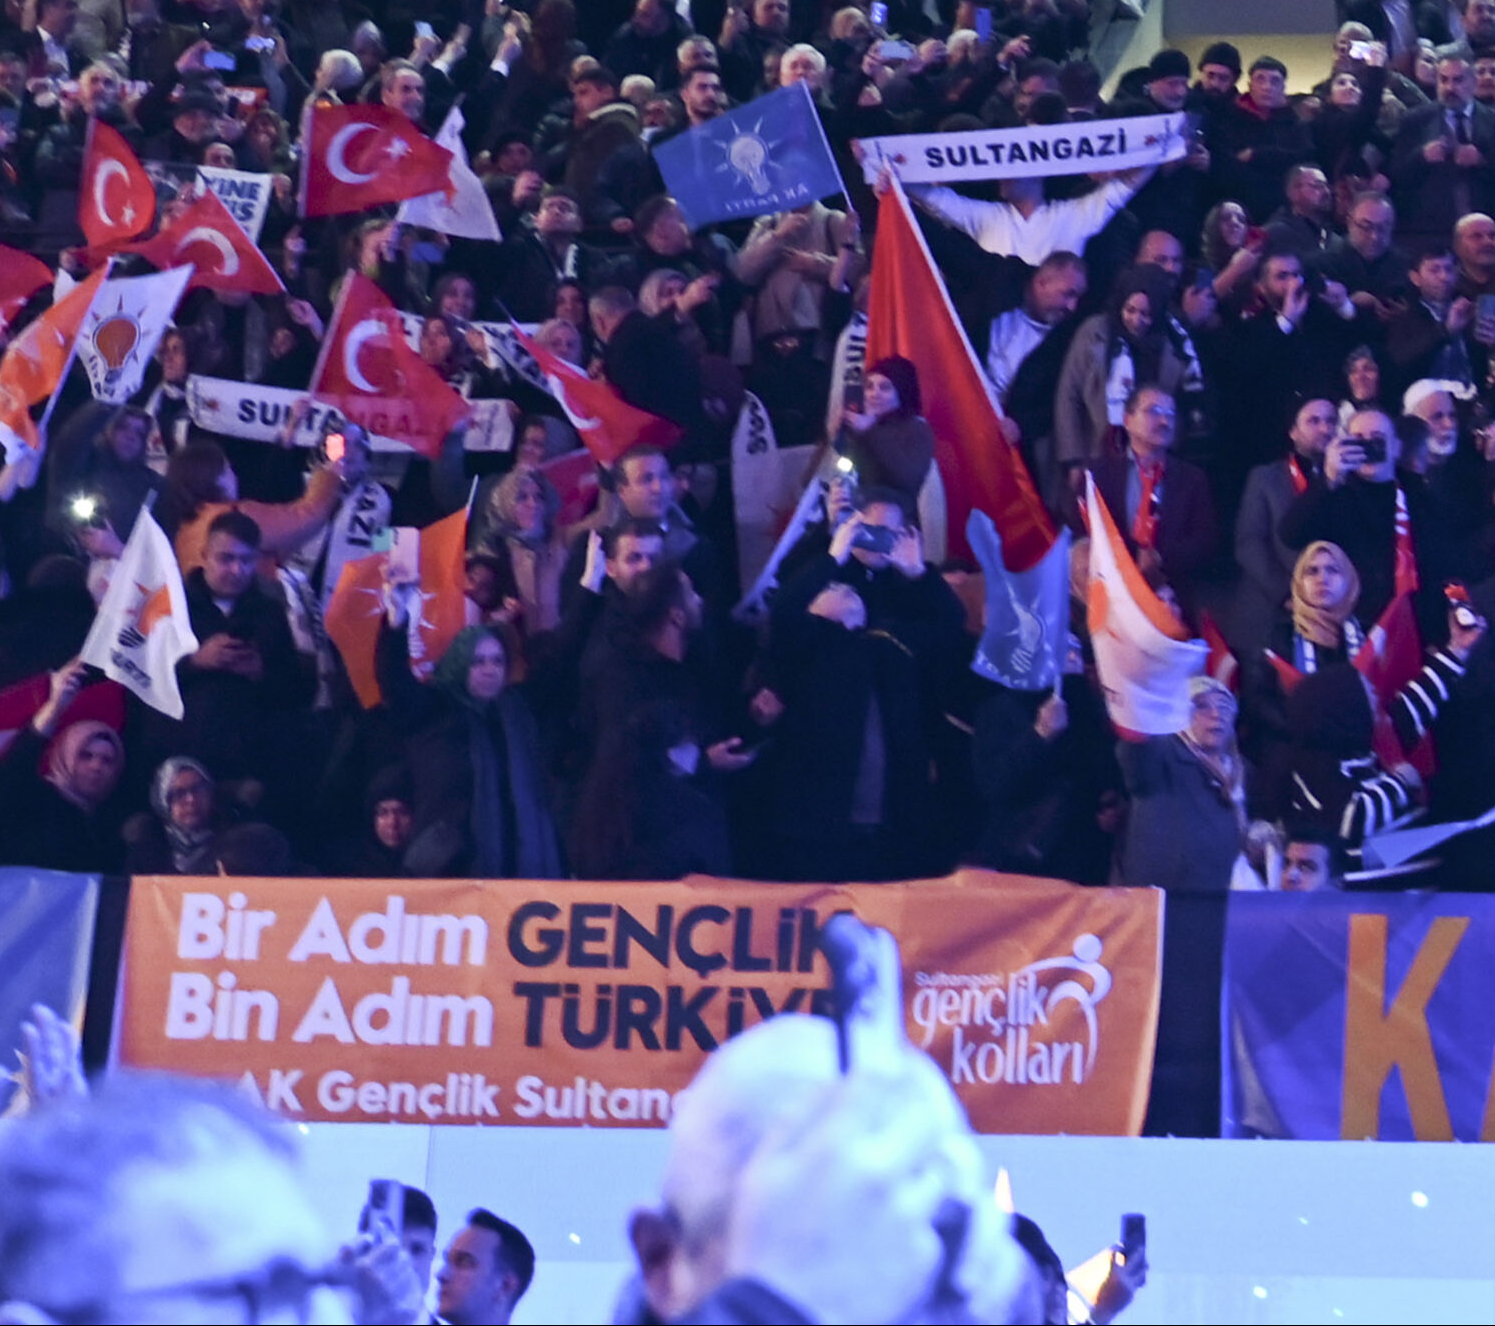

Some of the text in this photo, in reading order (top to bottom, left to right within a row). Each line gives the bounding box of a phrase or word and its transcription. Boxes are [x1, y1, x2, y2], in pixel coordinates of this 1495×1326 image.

[924, 127, 1127, 169] SULTANGAZİ
[176, 891, 277, 961] Bir
[286, 895, 490, 967] Adım
[165, 970, 280, 1042] Bin
[291, 975, 494, 1048] Adım
[912, 971, 1049, 1049] gençlik
[951, 1025, 1085, 1085] kolları
[316, 1069, 501, 1119] Gençlik
[513, 1075, 672, 1121] Sultan
